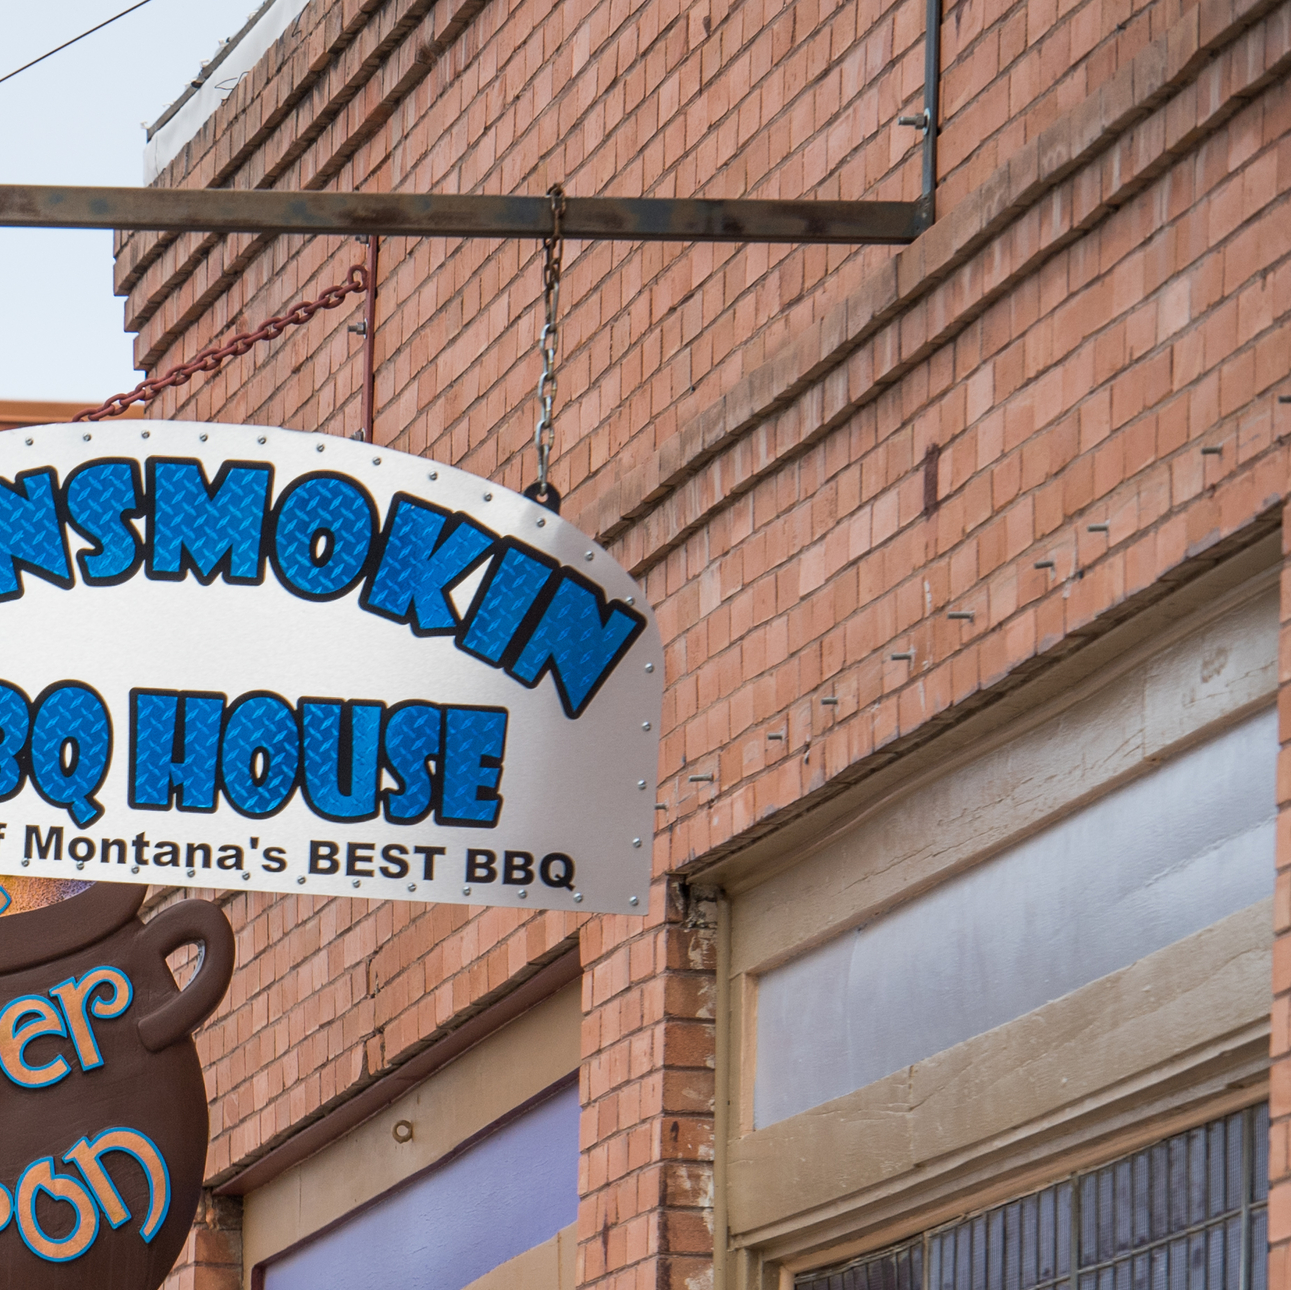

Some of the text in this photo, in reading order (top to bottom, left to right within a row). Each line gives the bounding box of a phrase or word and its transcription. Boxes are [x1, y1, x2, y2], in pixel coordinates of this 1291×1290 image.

[127, 688, 509, 828] HOUSE
[24, 824, 287, 873] Montana's
[309, 840, 445, 881] BEST
[465, 848, 576, 892] BBQ
